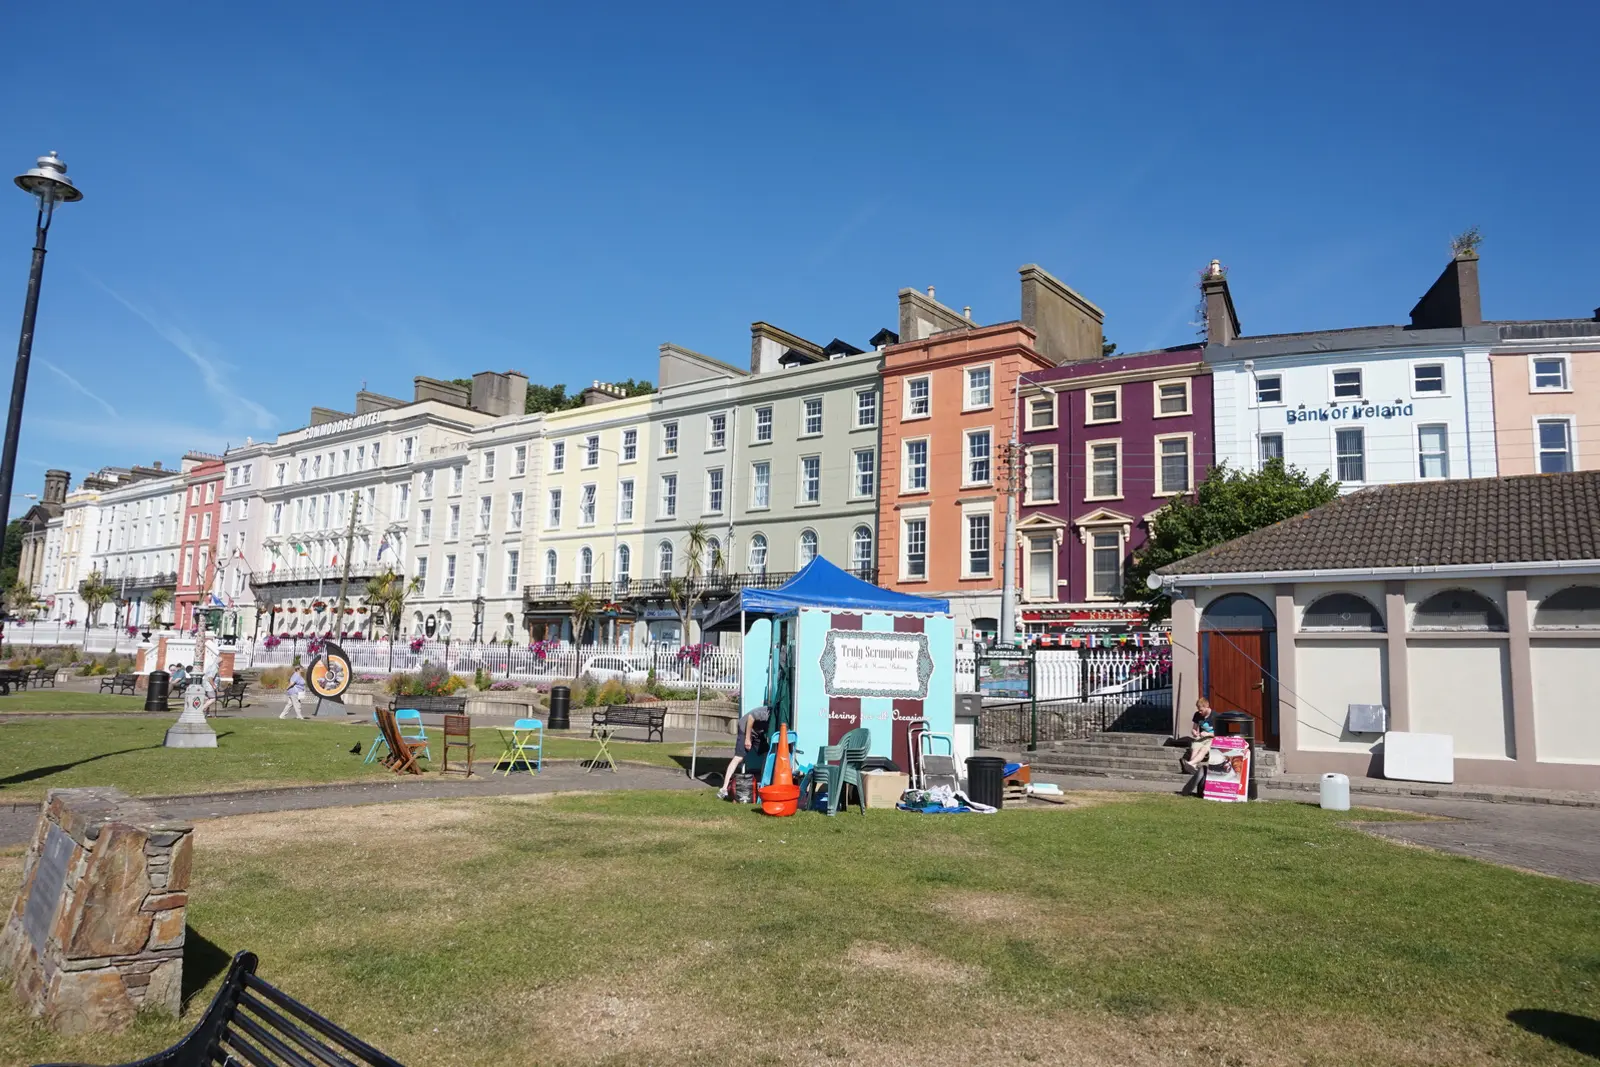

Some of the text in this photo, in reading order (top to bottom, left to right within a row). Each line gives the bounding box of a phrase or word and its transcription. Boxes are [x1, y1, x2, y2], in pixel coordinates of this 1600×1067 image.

[1286, 403, 1413, 423] Bank of Ireland
[304, 411, 381, 440] COMMODORE HOTEL
[841, 645, 914, 661] Truly Scrumptious
[819, 708, 857, 725] Catering
